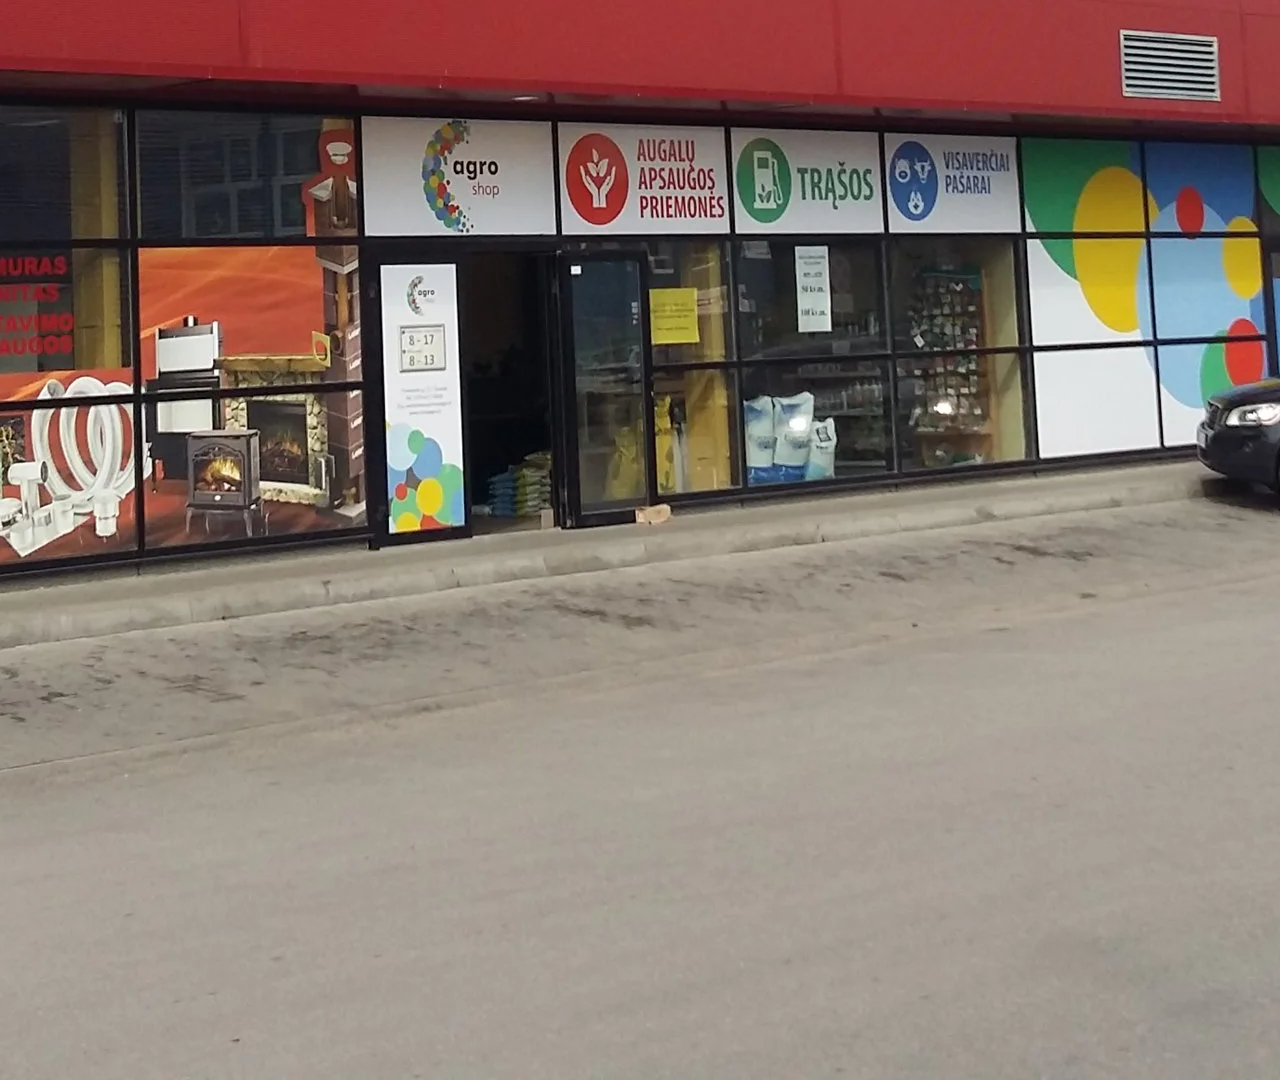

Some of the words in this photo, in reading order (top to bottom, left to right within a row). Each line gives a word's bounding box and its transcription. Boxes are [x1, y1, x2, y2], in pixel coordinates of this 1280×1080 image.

[636, 138, 695, 169] AUGALŲ
[943, 149, 1010, 172] VISAVERČIAI
[453, 158, 499, 180] agro
[638, 167, 716, 191] APSAUGOS
[472, 181, 500, 199] shop
[797, 161, 874, 210] TRĄŠOS
[945, 172, 991, 195] PAŠARAI
[640, 191, 725, 219] PRIEMONĖS
